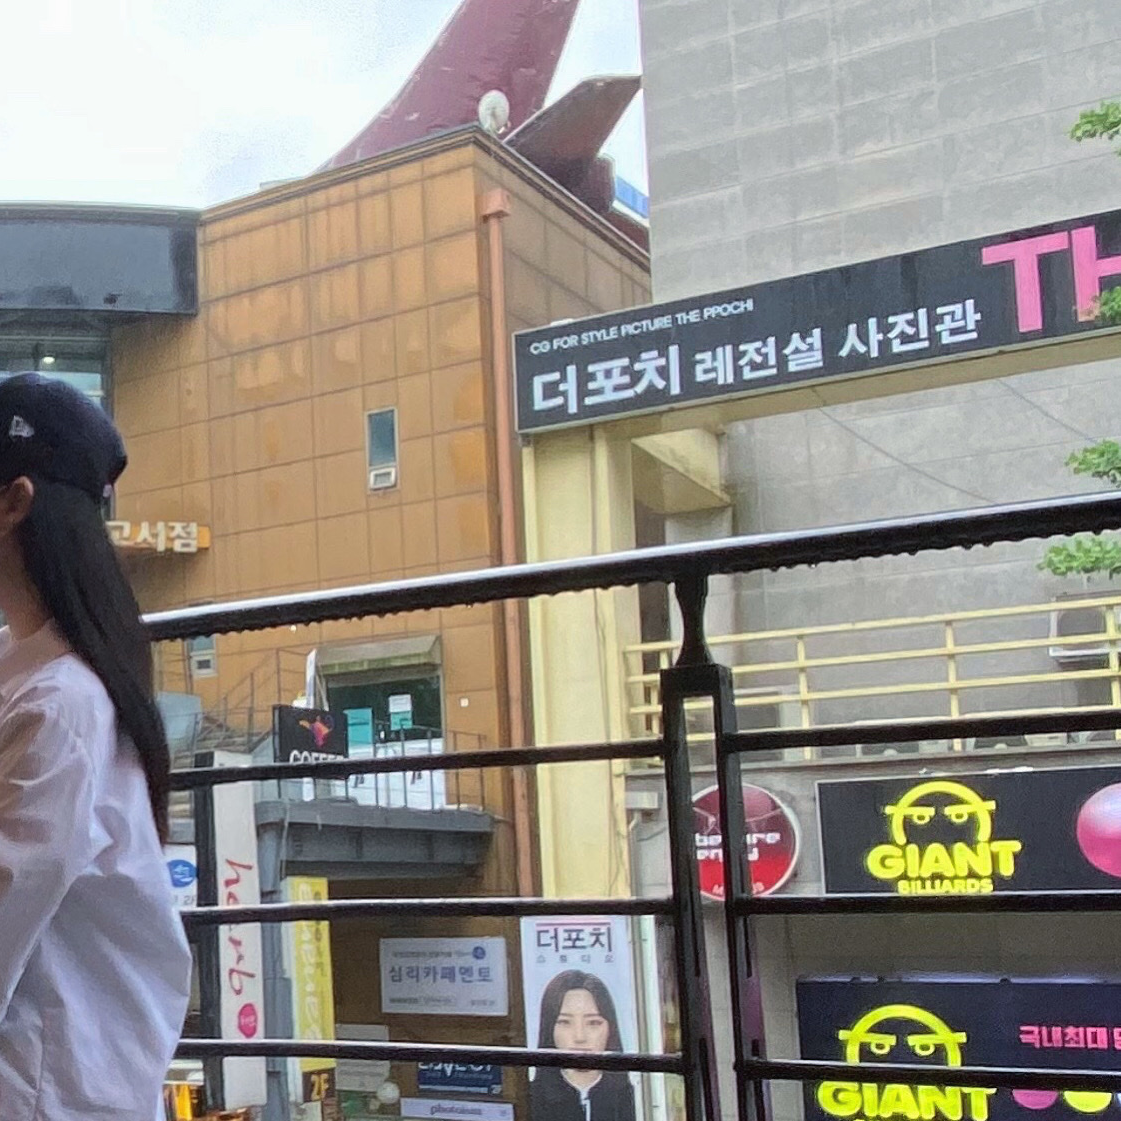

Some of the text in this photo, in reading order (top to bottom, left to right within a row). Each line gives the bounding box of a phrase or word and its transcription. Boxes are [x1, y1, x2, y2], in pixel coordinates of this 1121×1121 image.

[553, 336, 578, 350] FOR
[581, 326, 618, 345] STYLE
[621, 318, 672, 337] PICTURE
[675, 310, 701, 325] THE
[704, 299, 754, 319] PPOCHI
[532, 299, 982, 414] 더포치 레전설 사진관
[867, 839, 1021, 880] GIANT
[898, 879, 993, 894] BILLIARDS
[536, 926, 612, 953] 더포치
[389, 965, 493, 983] 심리카페멘토
[817, 1081, 997, 1121] GIANT
